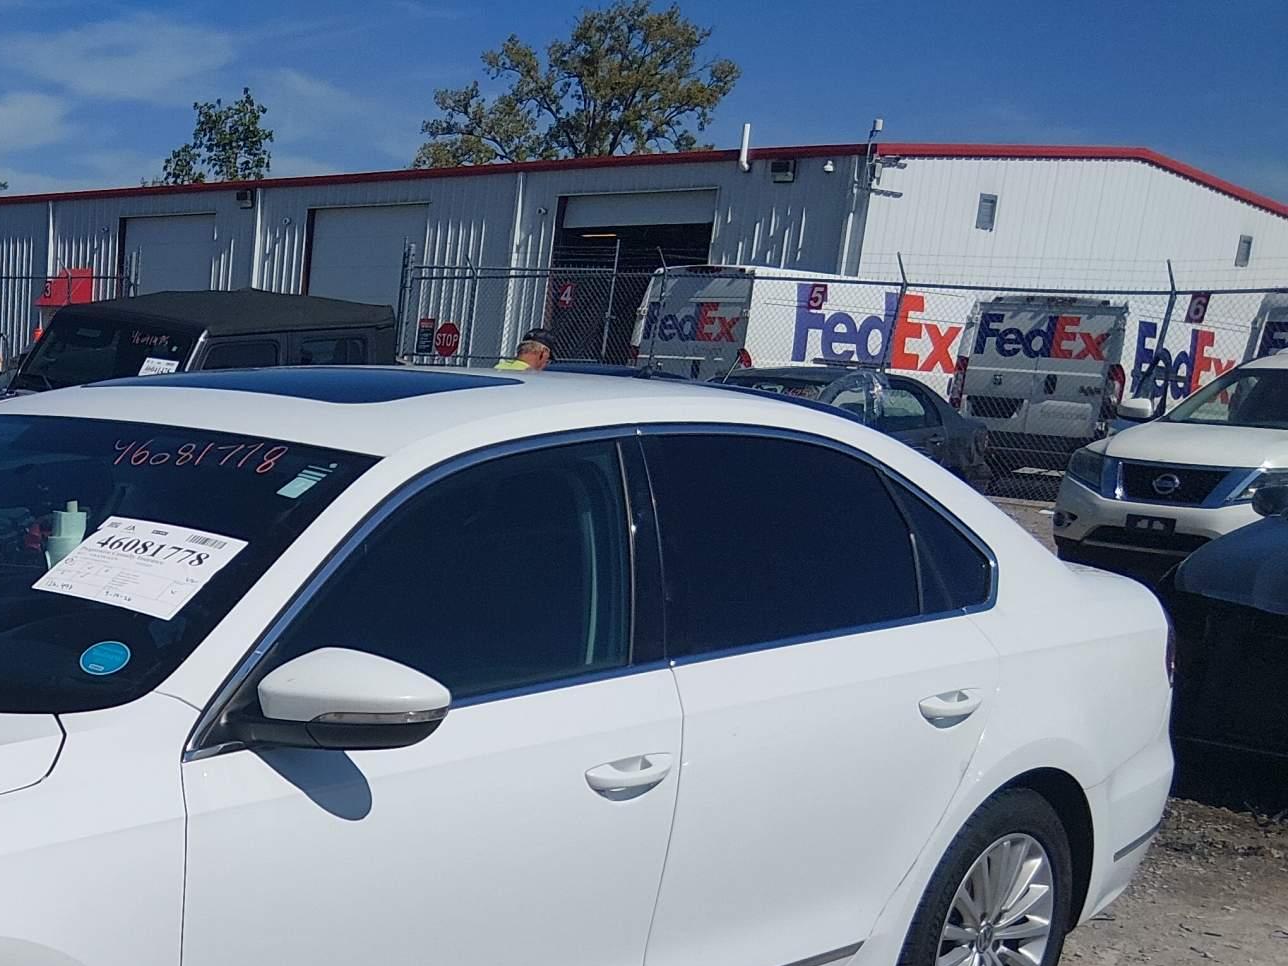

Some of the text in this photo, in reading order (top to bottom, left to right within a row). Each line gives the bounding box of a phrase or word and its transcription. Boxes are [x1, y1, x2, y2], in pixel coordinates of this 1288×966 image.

[44, 282, 51, 297] 3
[560, 285, 572, 304] 4
[809, 286, 825, 307] 5
[642, 301, 740, 342] FedEx
[1189, 297, 1205, 320] 6
[436, 333, 459, 347] STOP
[791, 283, 963, 374] FedEx
[974, 313, 1110, 361] FedEx
[114, 439, 289, 473] 46081778
[97, 535, 210, 567] 46081778
